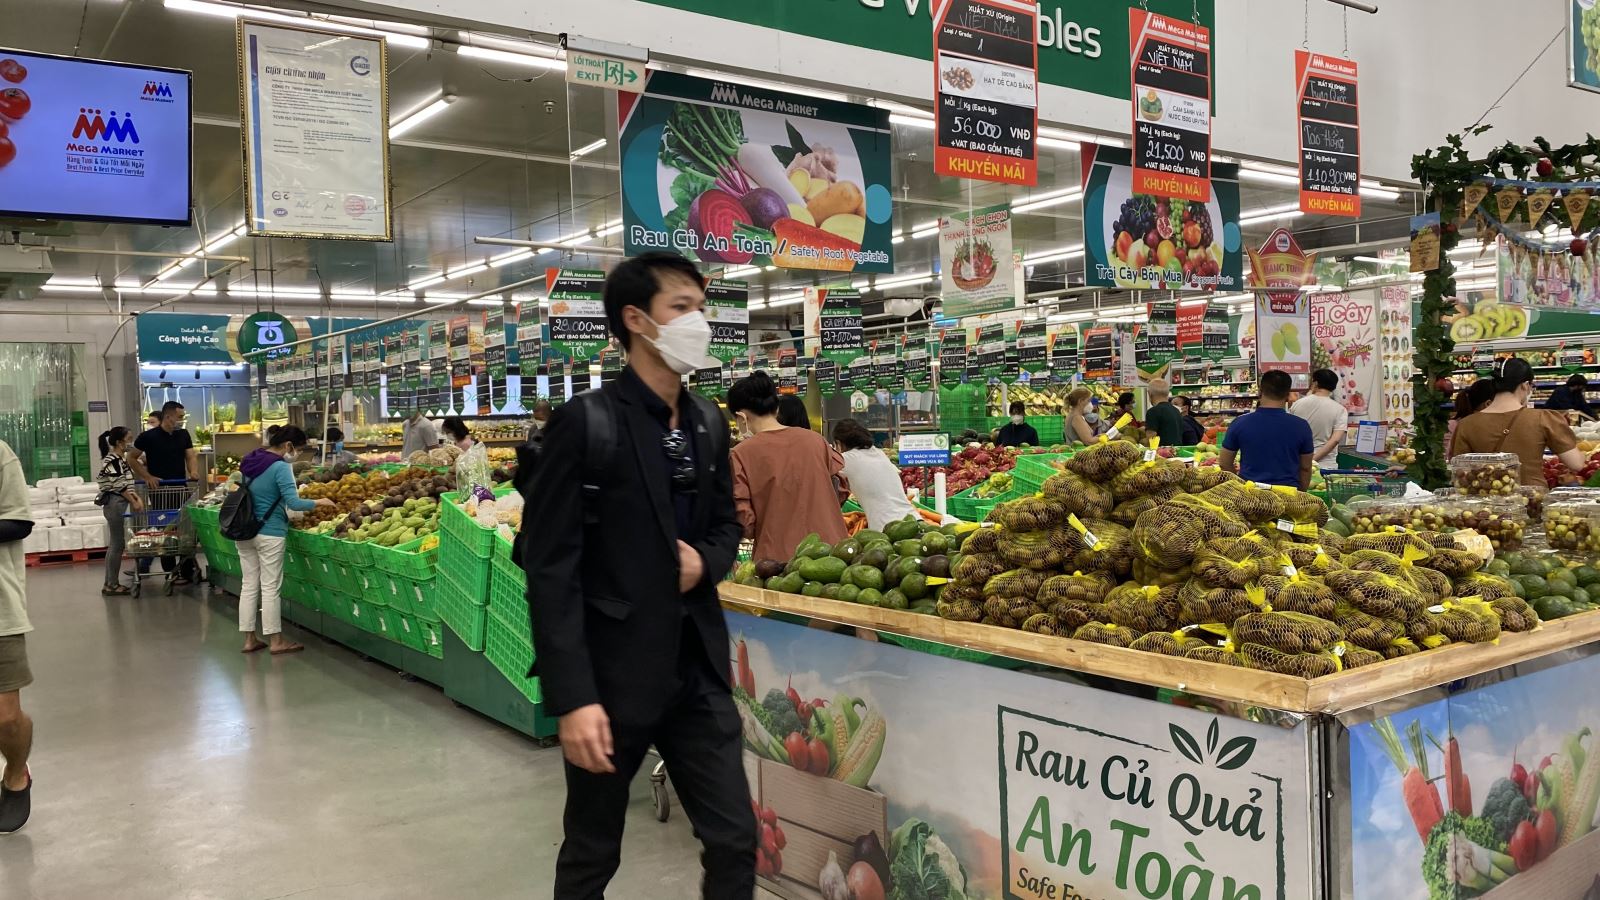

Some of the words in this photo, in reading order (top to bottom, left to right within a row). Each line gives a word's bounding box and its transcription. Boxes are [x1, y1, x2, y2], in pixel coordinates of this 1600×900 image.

[1173, 56, 1193, 73] NAM
[577, 71, 601, 81] EXIT
[951, 116, 1002, 139] 56.000
[1010, 126, 1031, 141] VNĐ
[951, 139, 968, 149] +VAT
[969, 141, 986, 151] (BAO
[1190, 150, 1206, 162] VNĐ
[949, 155, 1000, 177] KHUYẾN
[1003, 162, 1025, 180] MÃI
[1143, 176, 1183, 193] KHUYẾN
[1185, 182, 1201, 197] MÃI
[1308, 195, 1339, 210] KHUYẾN
[1341, 199, 1354, 212] MÃI
[631, 225, 668, 248] Rau
[673, 229, 698, 249] Củ
[704, 232, 729, 251] An
[733, 234, 773, 256] Toàn
[778, 238, 787, 256] /
[790, 245, 820, 259] Safety
[823, 248, 845, 259] Root
[847, 249, 889, 264] Vegetable
[1096, 263, 1116, 280] Trái
[1329, 302, 1372, 326] Cây
[158, 335, 180, 344] Công
[181, 335, 202, 344] Nghệ
[569, 346, 587, 358] TQ
[1015, 730, 1089, 790] Rau
[1100, 755, 1155, 809] Củ
[1167, 773, 1265, 842] Quả
[1015, 795, 1097, 876] An
[1017, 867, 1056, 900] Safe
